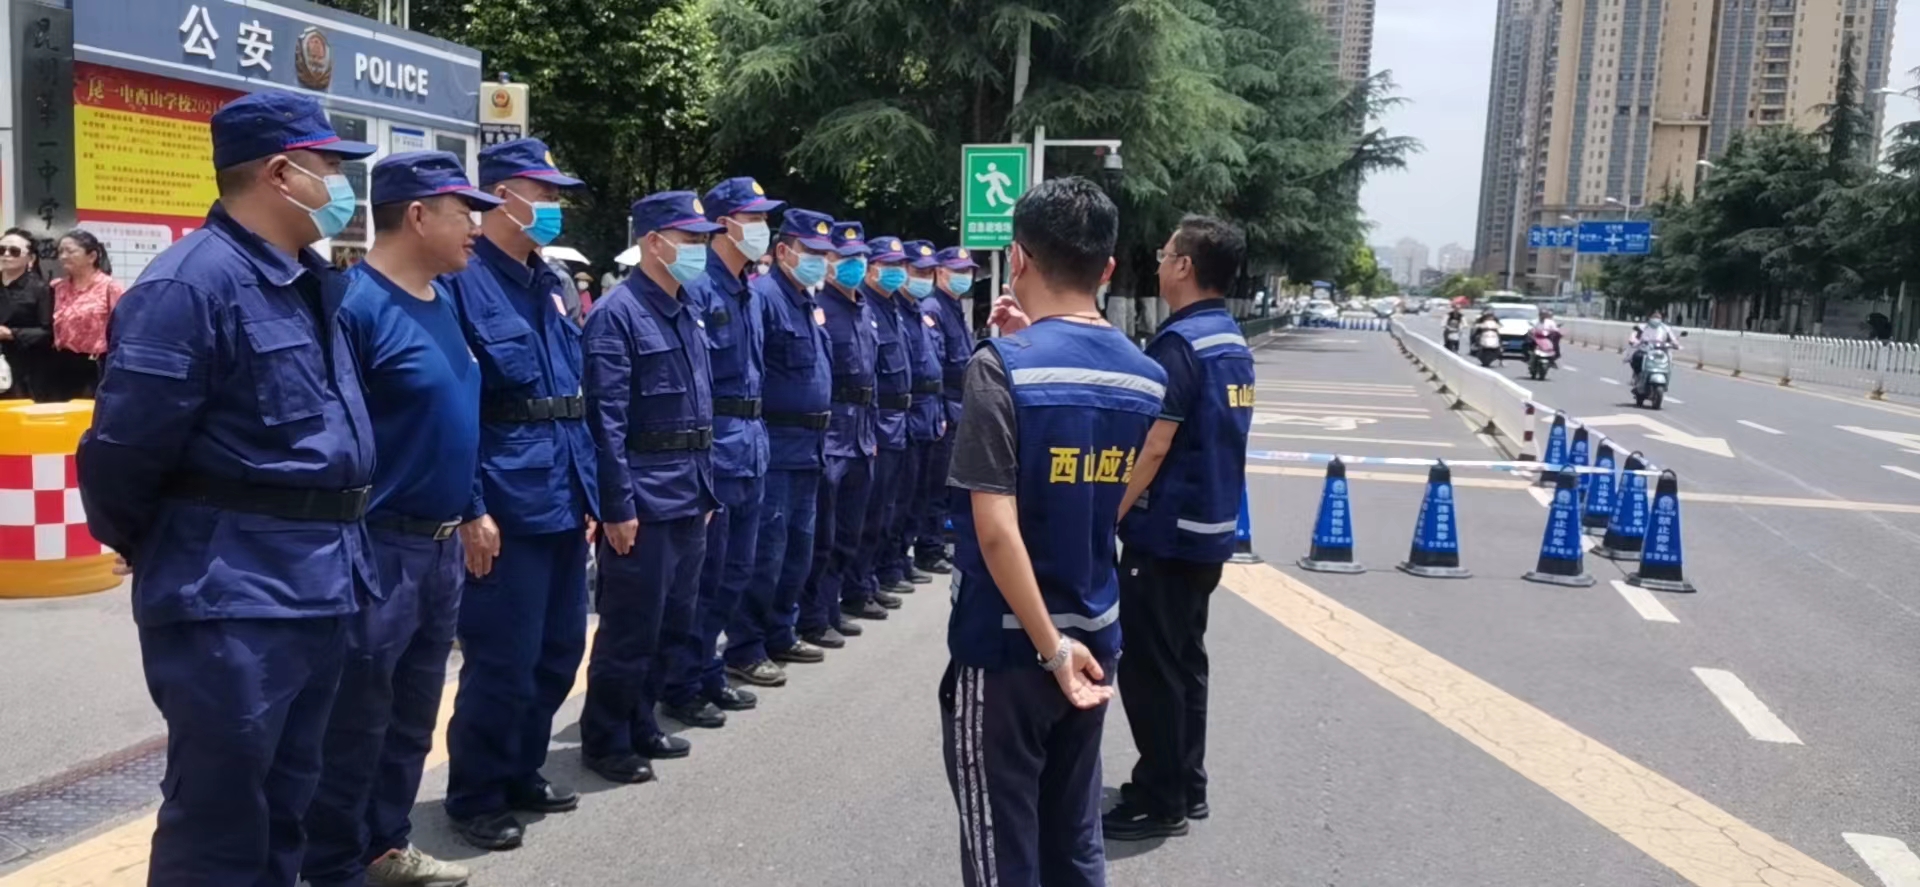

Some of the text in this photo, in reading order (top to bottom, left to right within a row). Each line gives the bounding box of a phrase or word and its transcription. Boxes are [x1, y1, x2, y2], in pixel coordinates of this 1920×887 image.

[180, 4, 274, 71] 公安
[355, 52, 428, 96] POLICE
[88, 77, 224, 115] 昆一中西山学校2021
[1656, 516, 1672, 552] 禁止停车
